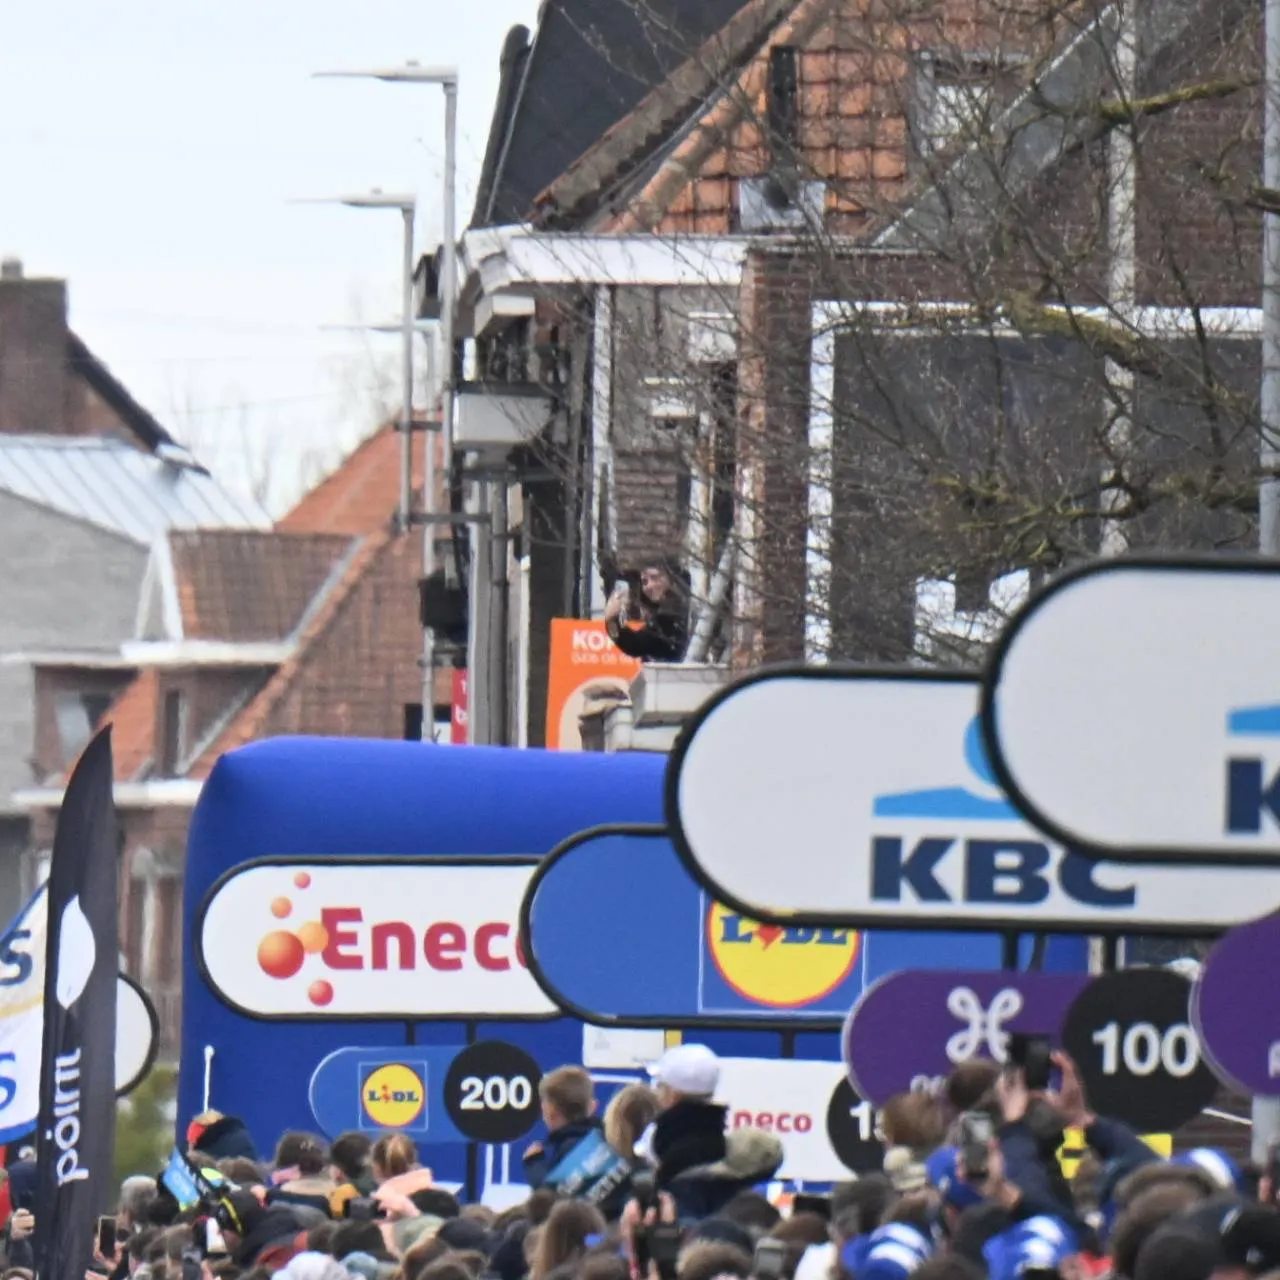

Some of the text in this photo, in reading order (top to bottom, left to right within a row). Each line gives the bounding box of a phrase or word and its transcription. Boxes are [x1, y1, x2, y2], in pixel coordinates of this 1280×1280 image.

[870, 836, 1137, 909] KBC
[320, 906, 528, 972] Enec
[1092, 1020, 1201, 1078] 100
[460, 1075, 533, 1111] 200
